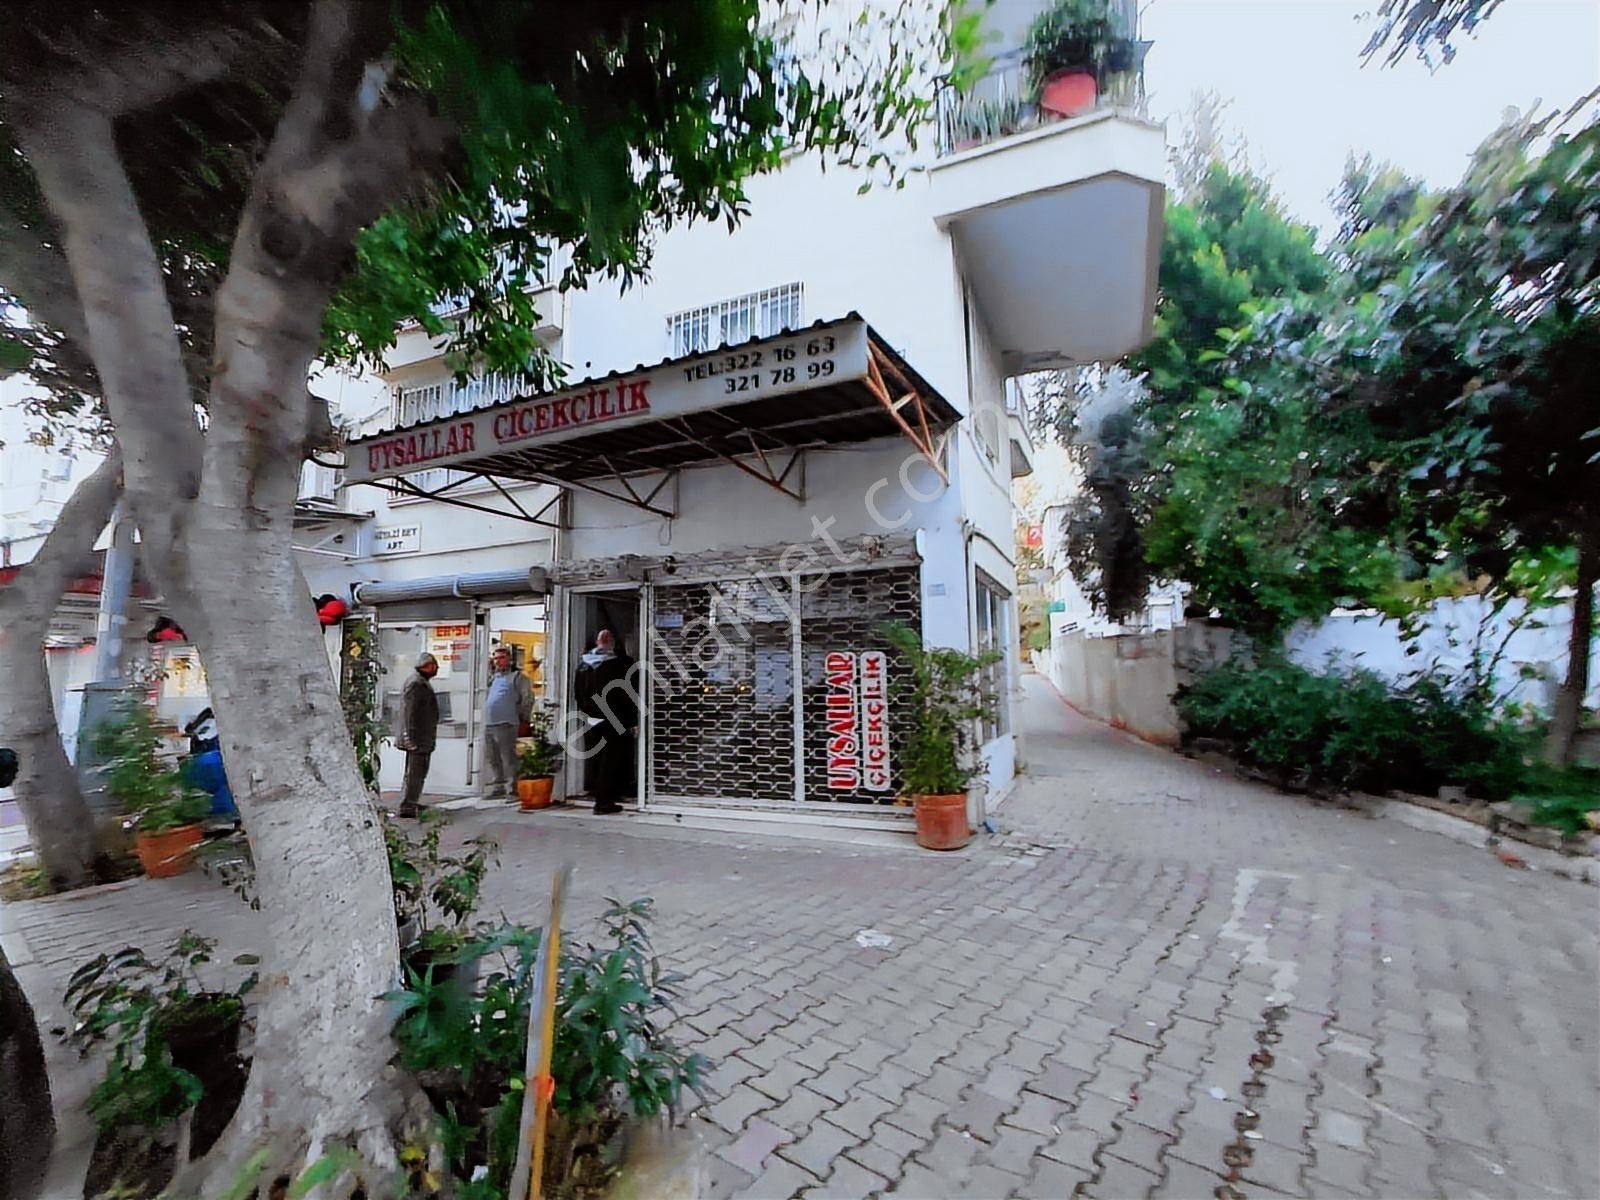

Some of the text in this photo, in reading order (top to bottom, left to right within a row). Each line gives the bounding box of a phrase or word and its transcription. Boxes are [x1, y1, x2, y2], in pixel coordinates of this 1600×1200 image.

[774, 345, 796, 363] 16
[807, 336, 835, 356] 63
[725, 359, 835, 394] 321 78 99
[368, 421, 475, 472] UYSALLAR
[827, 652, 858, 789] UYSALLAR
[864, 656, 887, 786] ÇİÇEKÇİLİK
